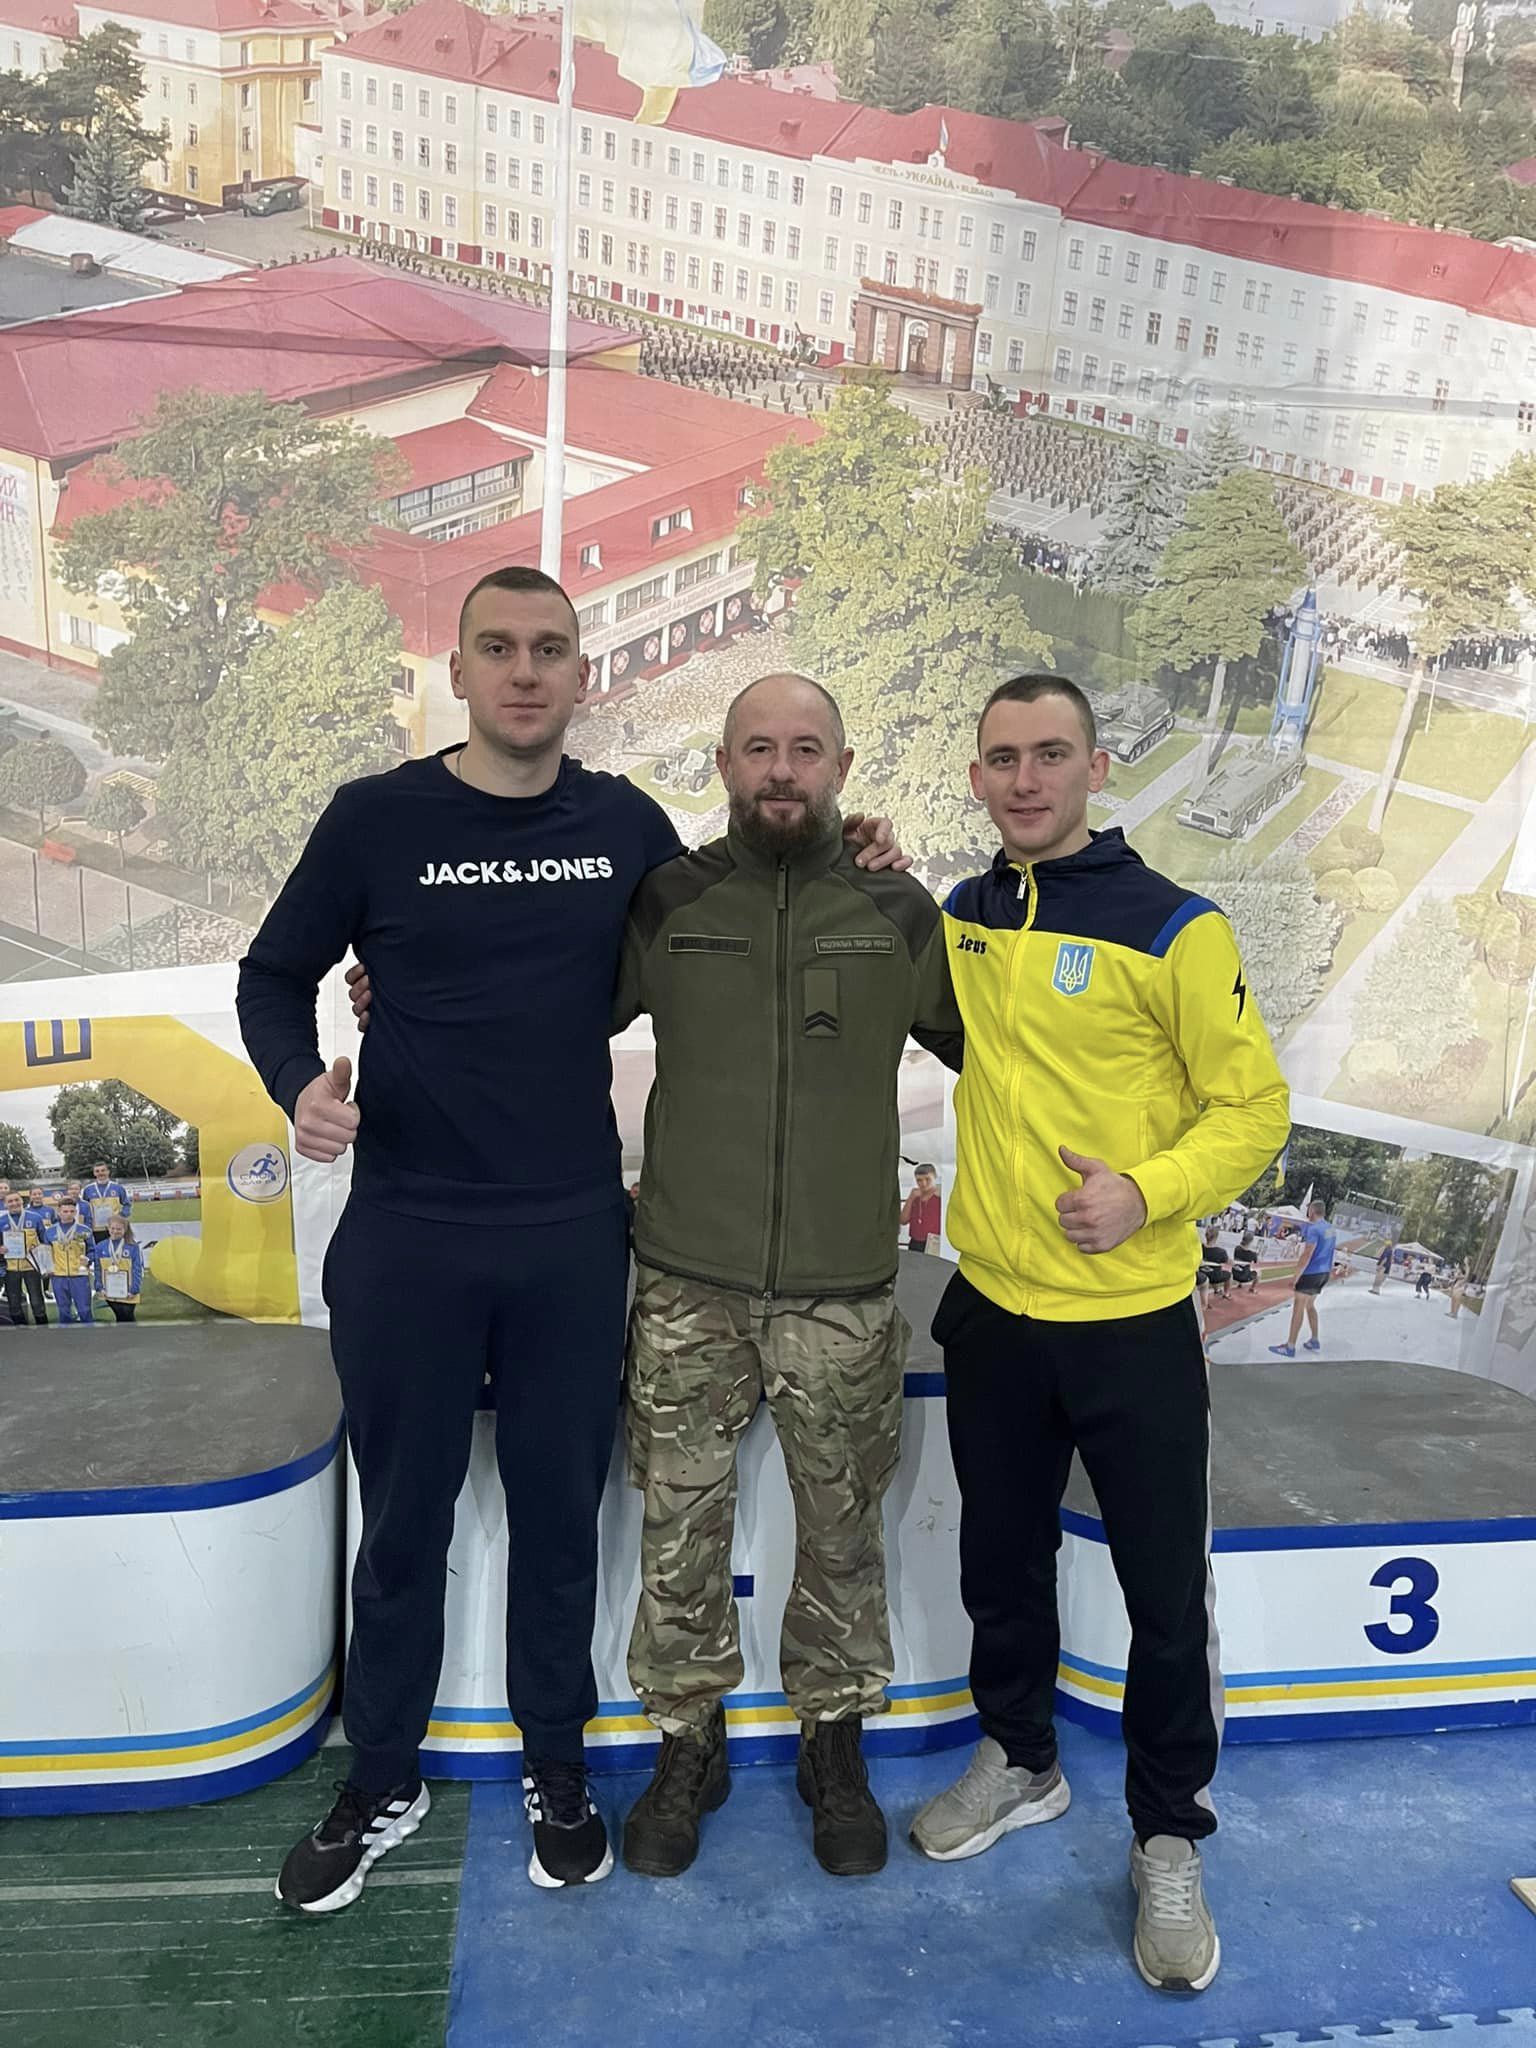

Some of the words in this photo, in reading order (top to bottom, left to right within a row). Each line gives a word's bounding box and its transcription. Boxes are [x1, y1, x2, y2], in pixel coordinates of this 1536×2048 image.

[905, 170, 955, 190] УКРАЇНА
[418, 856, 614, 886] JACK&JONES
[956, 933, 988, 955] Zeus
[1363, 1556, 1440, 1655] 3
